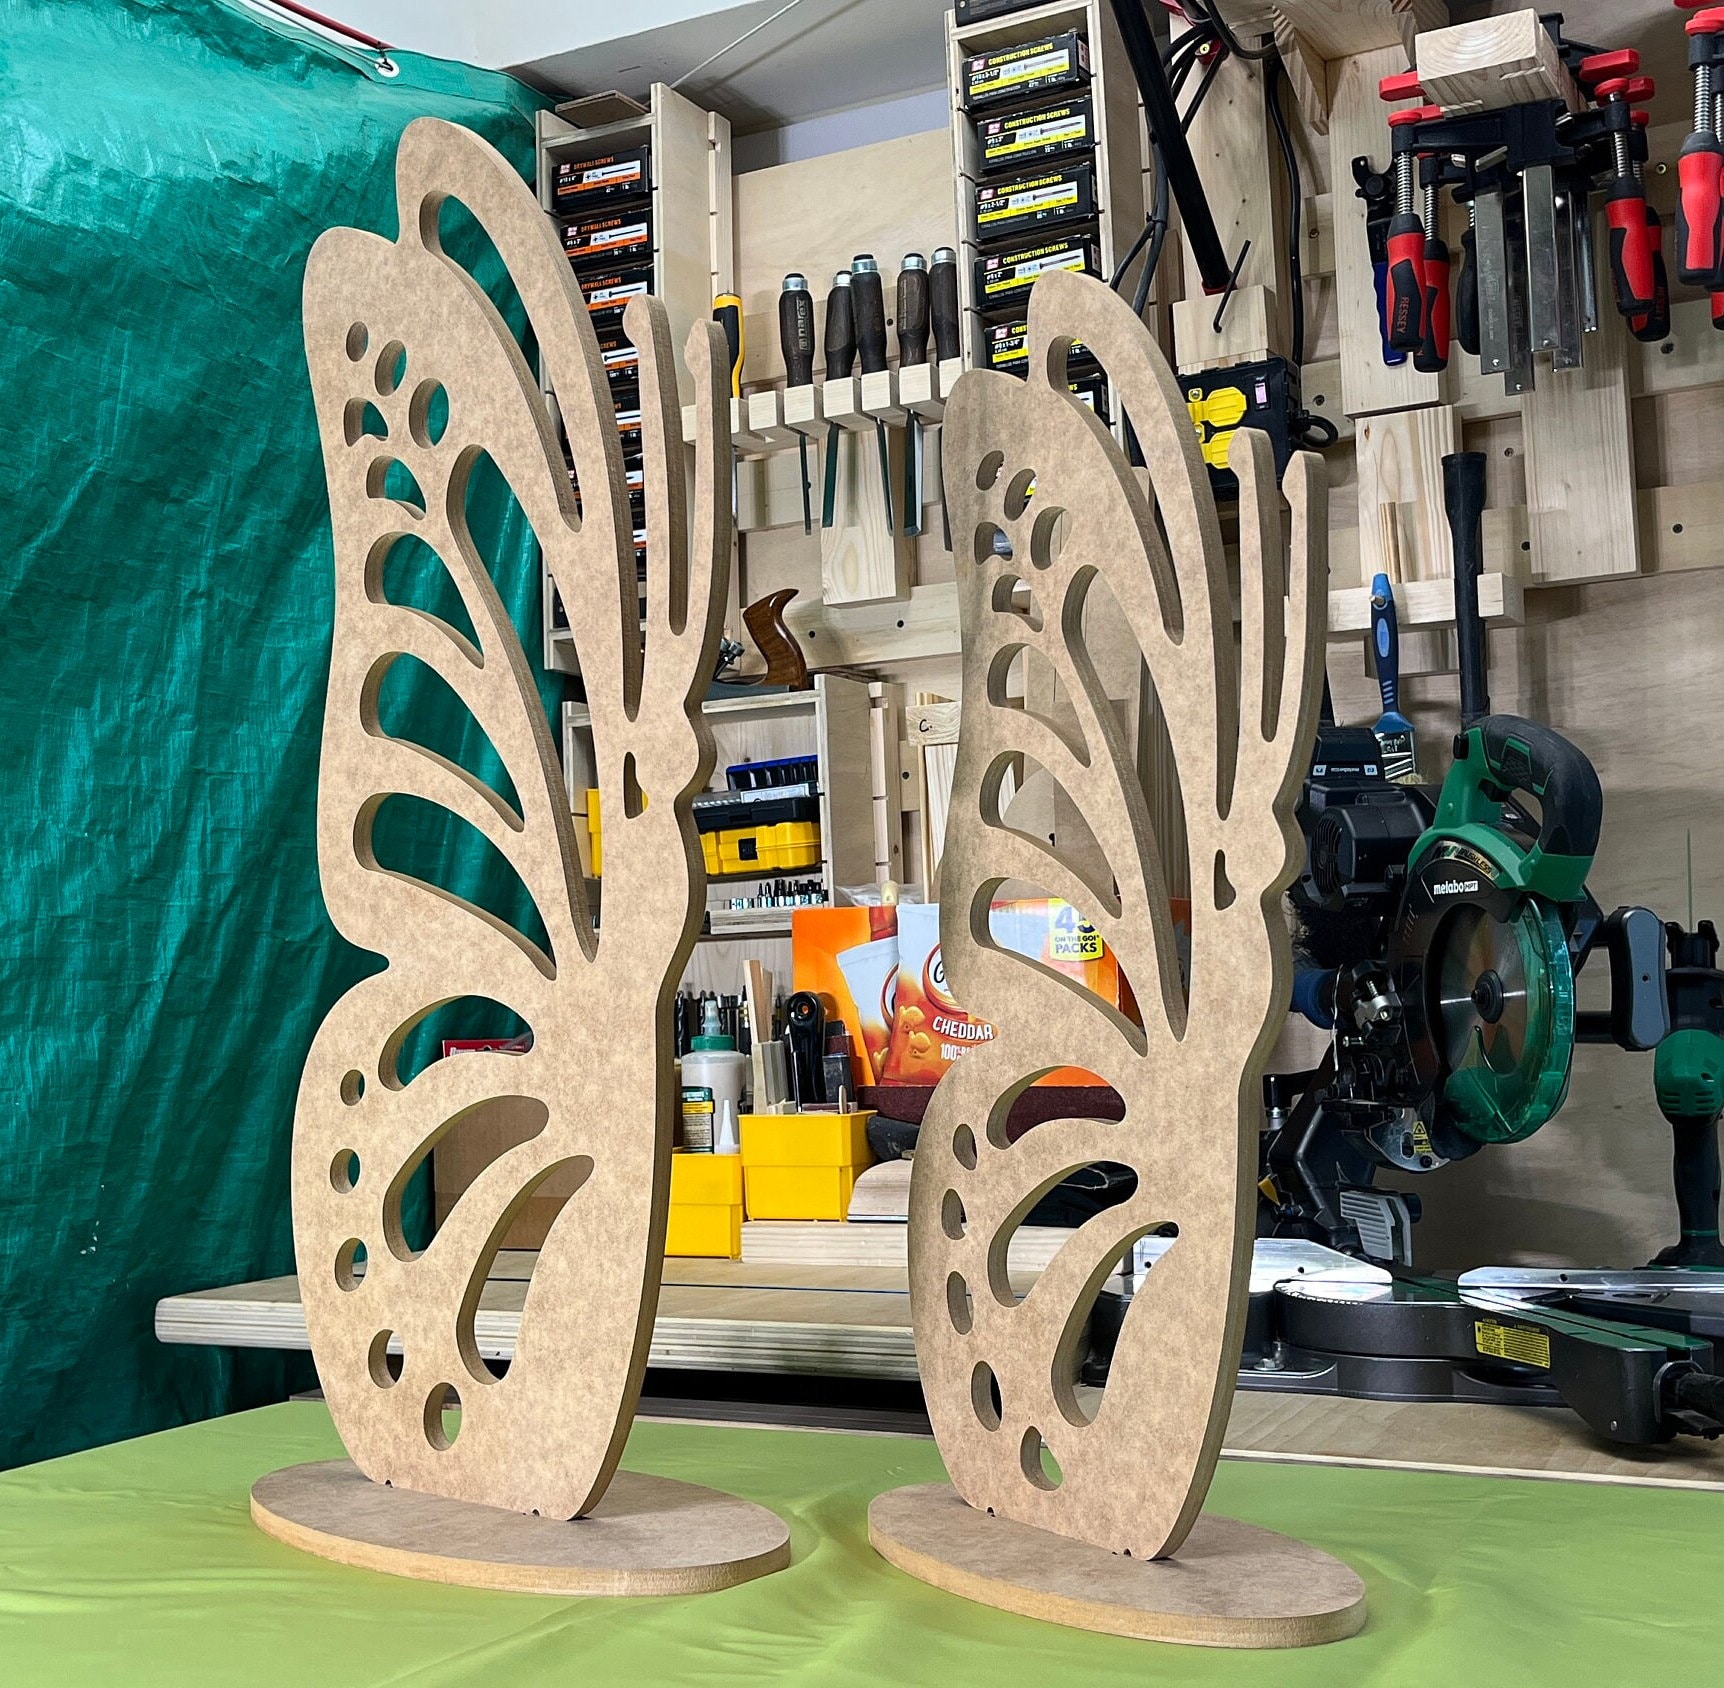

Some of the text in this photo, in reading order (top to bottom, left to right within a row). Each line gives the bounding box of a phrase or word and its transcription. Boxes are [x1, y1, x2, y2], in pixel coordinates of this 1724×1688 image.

[988, 49, 1030, 66] CONSTRUCTION
[1030, 42, 1053, 55] SCREWS
[1004, 113, 1046, 129] CONSTRUCTION
[1046, 108, 1070, 119] SCREWS
[594, 156, 614, 166] SCREWS
[997, 181, 1038, 195] CONSTRUCTION
[1039, 174, 1062, 186] SCREWS
[602, 218, 622, 229] SCREWS
[1003, 248, 1044, 265] CONSTRUCTION
[1044, 242, 1069, 254] SCREWS
[796, 296, 807, 337] narex
[1458, 847, 1492, 874] BRUSHLESS
[1433, 880, 1464, 895] metabo
[1055, 942, 1098, 954] PACKS
[932, 1015, 994, 1041] CHEDDAR
